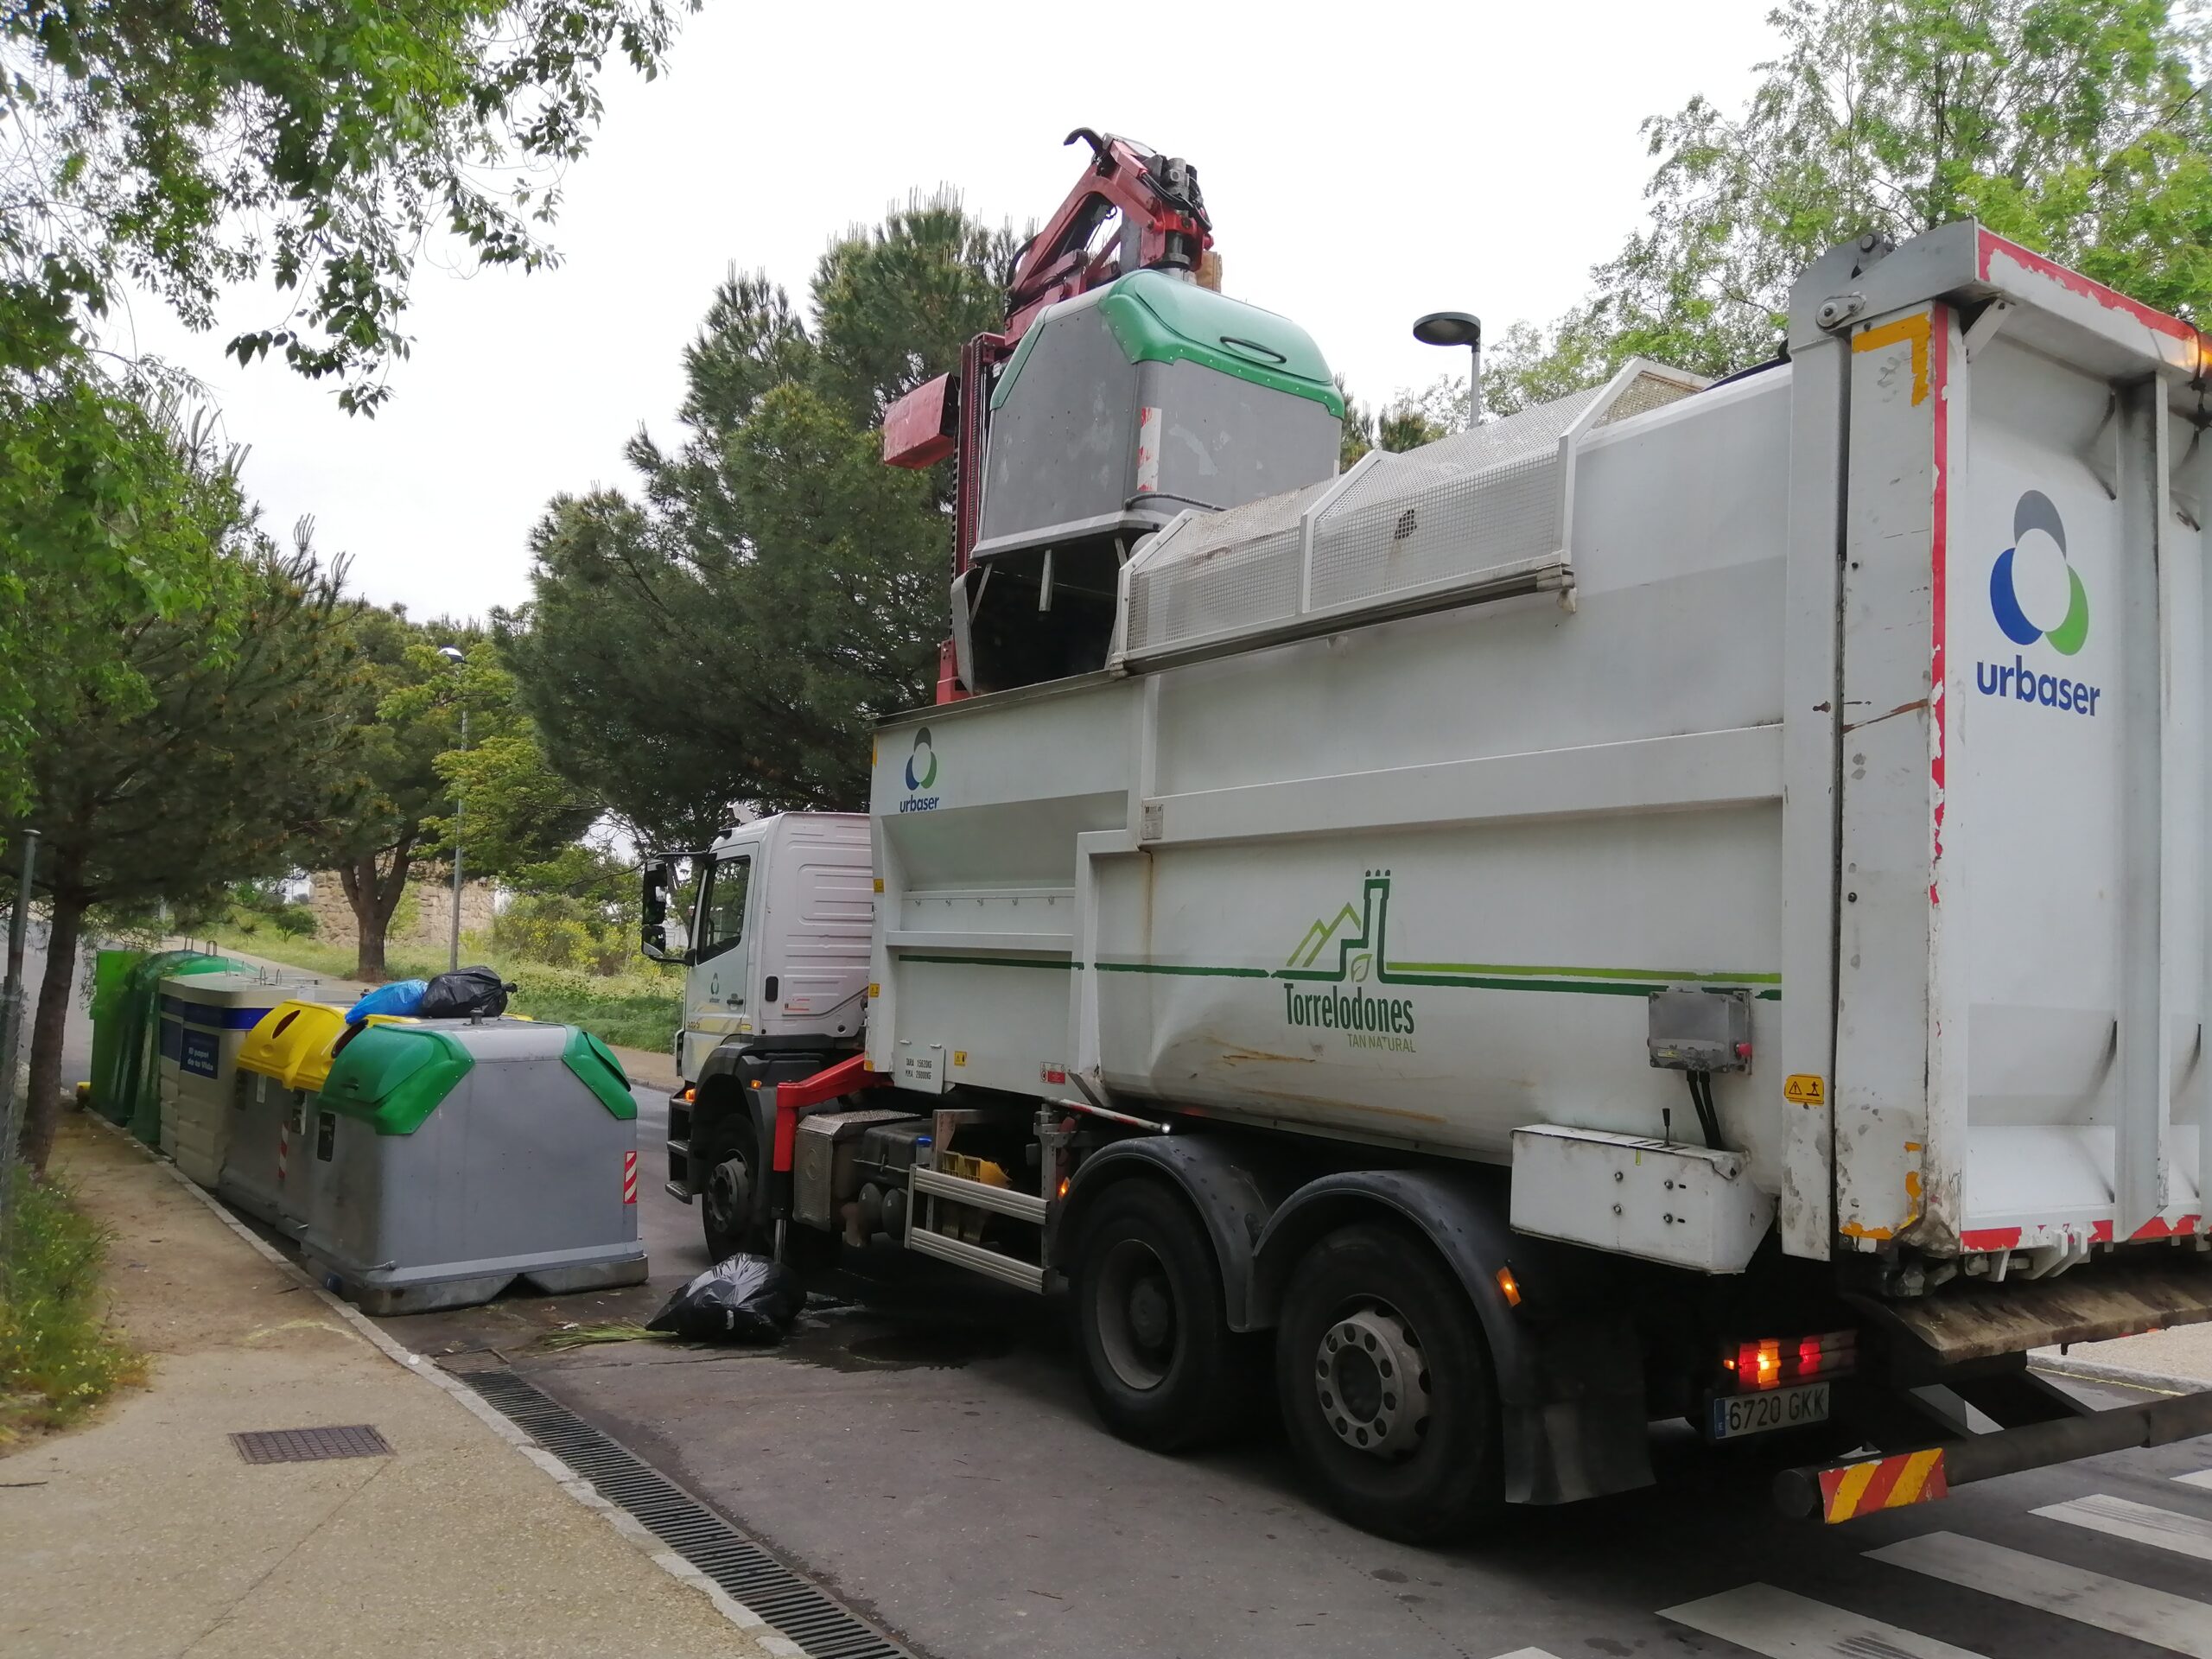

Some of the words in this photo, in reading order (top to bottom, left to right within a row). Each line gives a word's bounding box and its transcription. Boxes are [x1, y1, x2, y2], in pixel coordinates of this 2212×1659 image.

[1977, 654, 2101, 717] urbaser
[899, 794, 940, 813] urbaser
[1283, 982, 1415, 1035] Torrelodones
[1347, 1033, 1367, 1049] TAN
[1368, 1035, 1417, 1053] NATURAL
[1729, 1395, 1782, 1432] 6720
[1788, 1387, 1826, 1421] GKK
